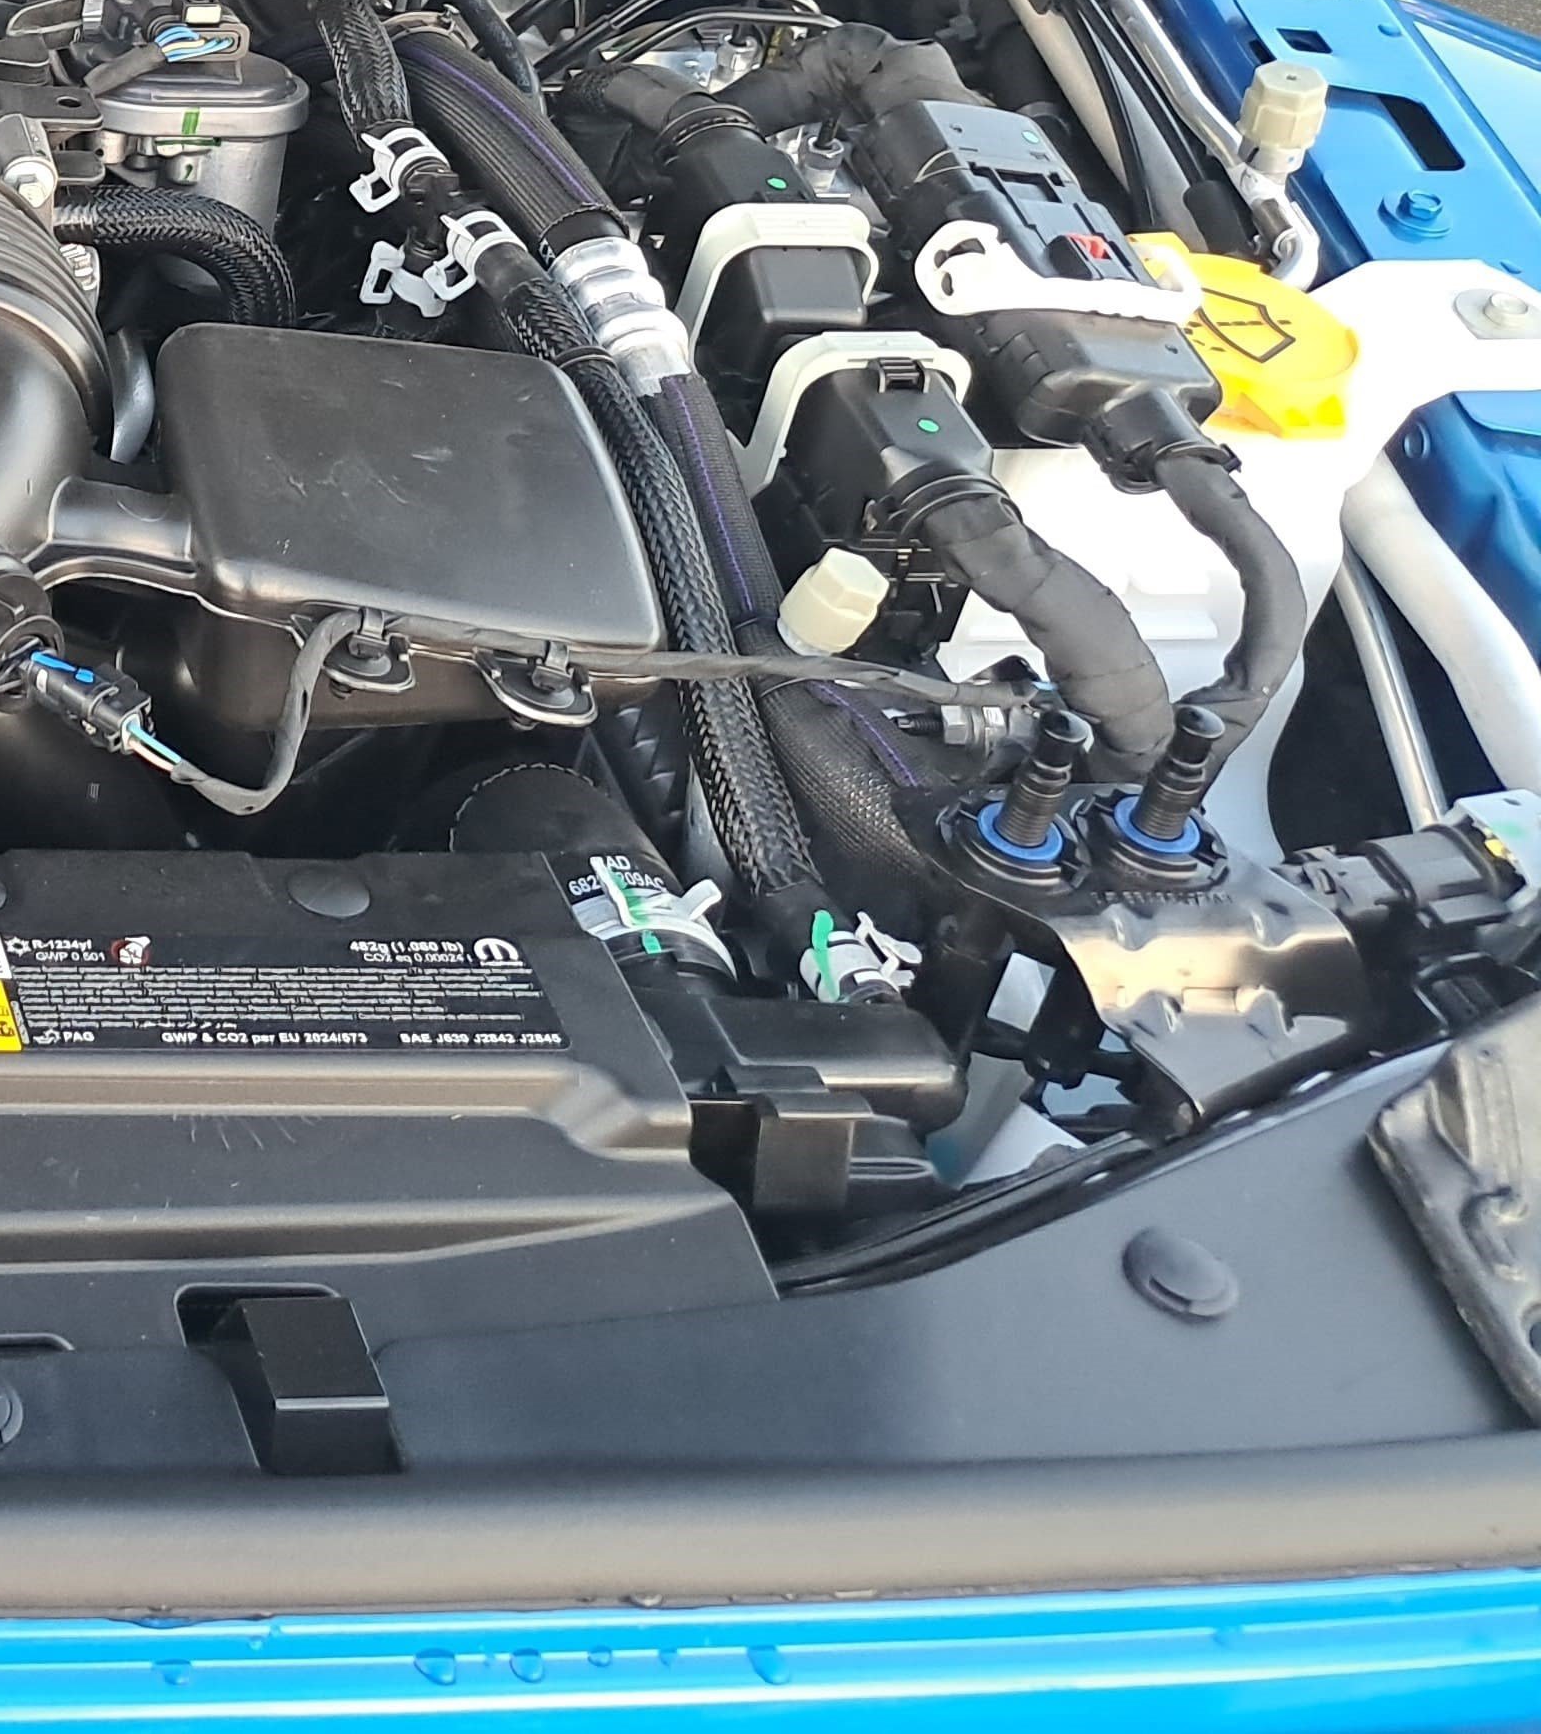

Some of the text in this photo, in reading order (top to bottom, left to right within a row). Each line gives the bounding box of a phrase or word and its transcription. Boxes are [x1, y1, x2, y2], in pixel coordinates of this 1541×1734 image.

[599, 855, 631, 870] AD
[568, 872, 667, 896] 682209AC
[35, 952, 68, 962] GWP
[63, 1032, 95, 1043] PAG
[161, 1032, 198, 1043] GWP
[216, 1032, 249, 1043] CO2
[251, 1034, 276, 1045] per
